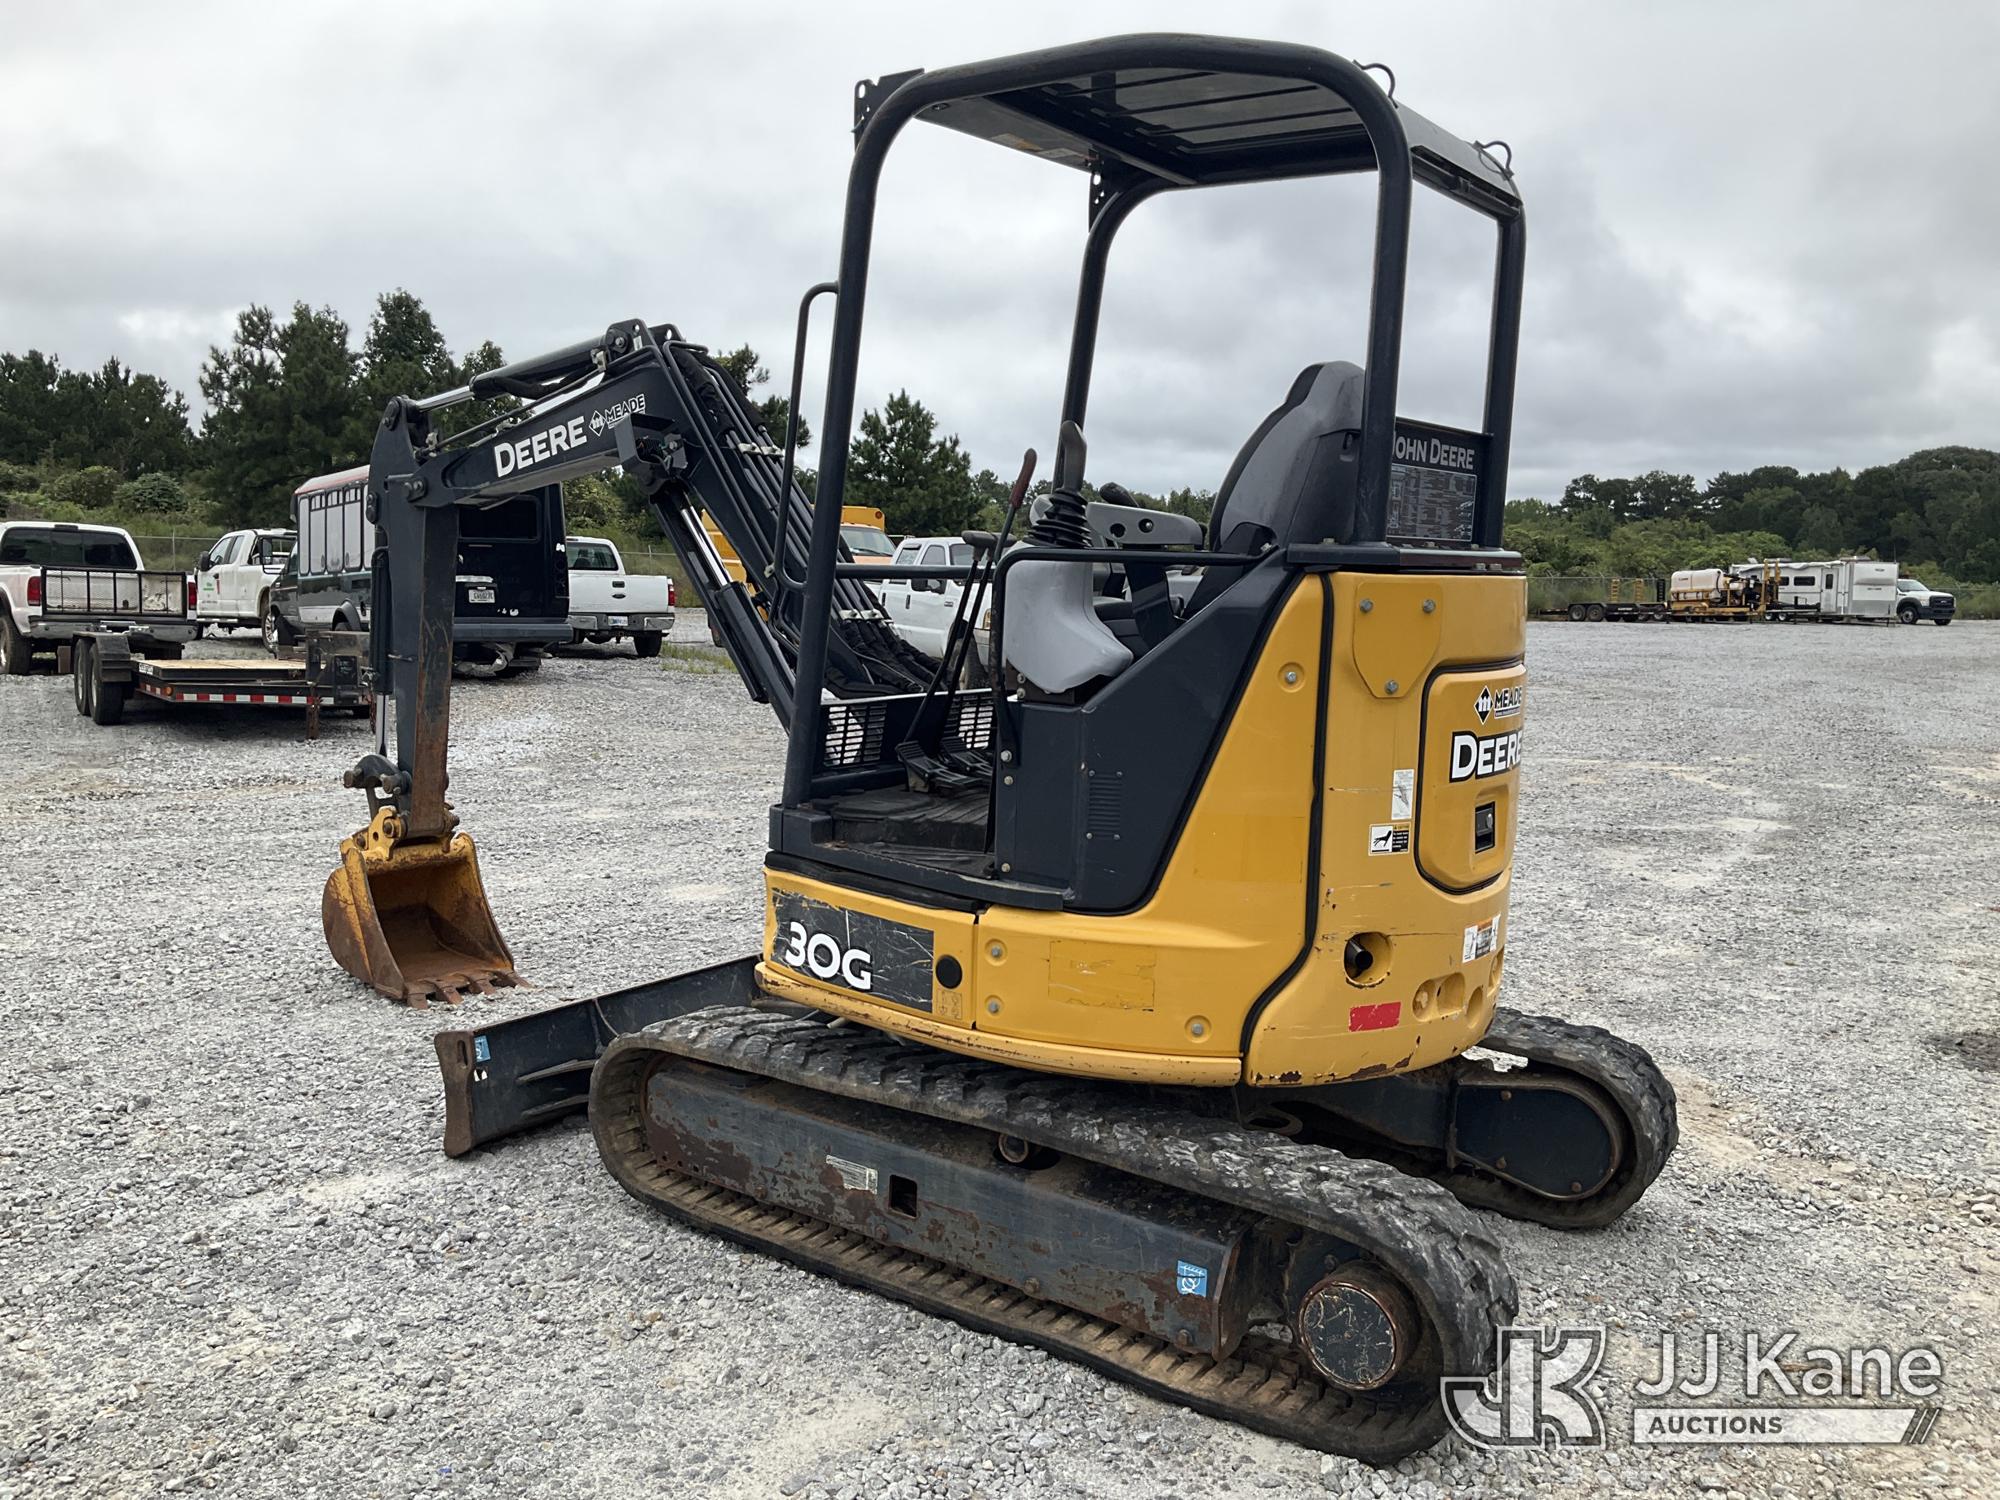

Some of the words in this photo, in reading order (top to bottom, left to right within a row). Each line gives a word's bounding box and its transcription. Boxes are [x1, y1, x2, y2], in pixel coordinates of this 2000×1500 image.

[605, 394, 645, 421] MEADE
[494, 416, 587, 478] DEERE
[1430, 438, 1475, 469] DEERE
[1452, 730, 1522, 778] DEERE
[786, 922, 871, 989] 30G
